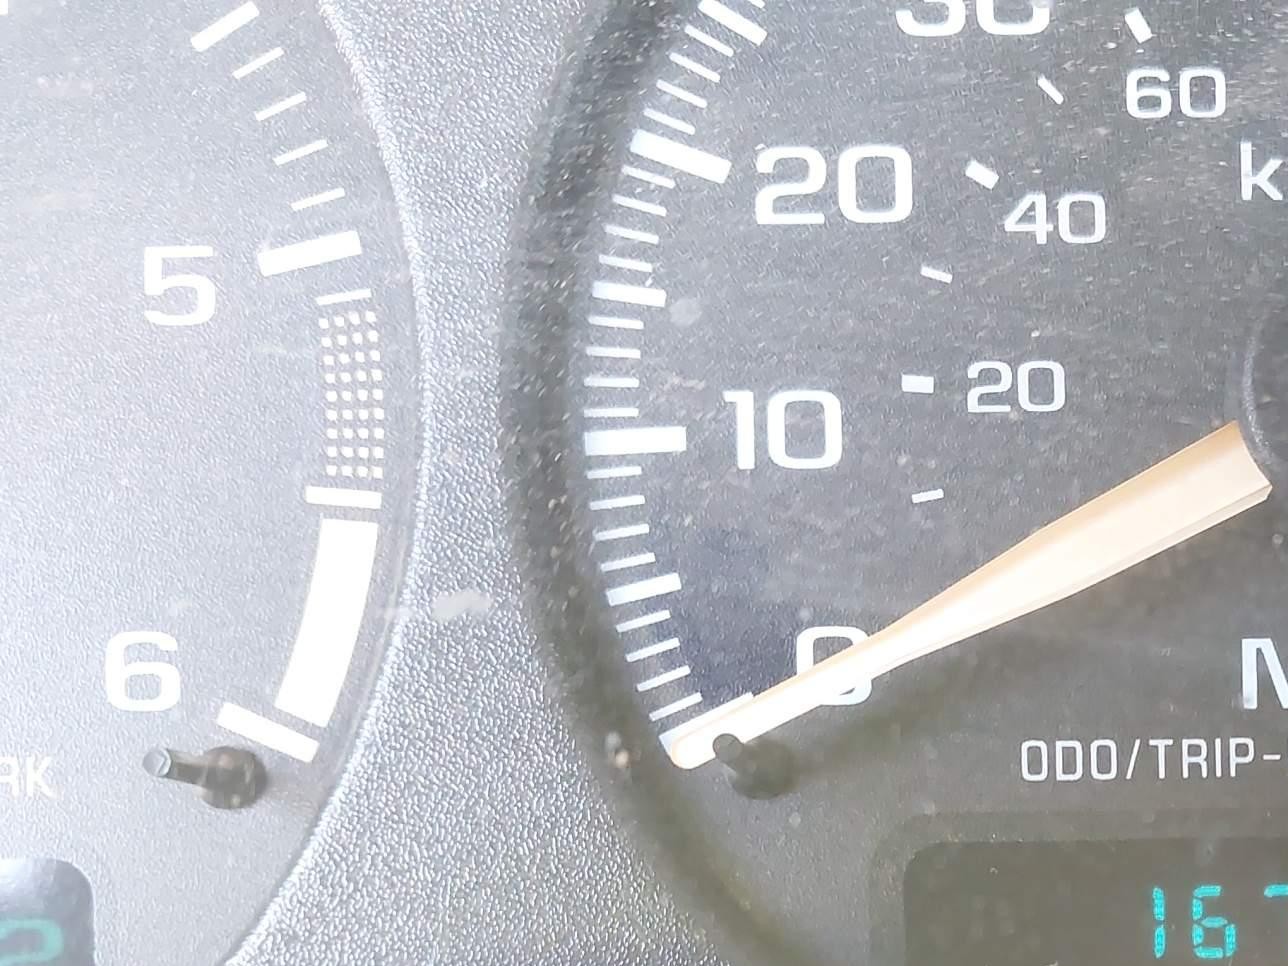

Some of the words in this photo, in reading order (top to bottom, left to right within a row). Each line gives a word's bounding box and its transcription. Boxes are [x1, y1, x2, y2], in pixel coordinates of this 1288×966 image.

[1126, 66, 1226, 118] 60
[754, 145, 912, 224] 20
[1004, 192, 1105, 244] 40
[143, 246, 215, 325] 5
[968, 361, 1065, 412] 20
[723, 389, 842, 469] 10
[104, 631, 181, 711] 6
